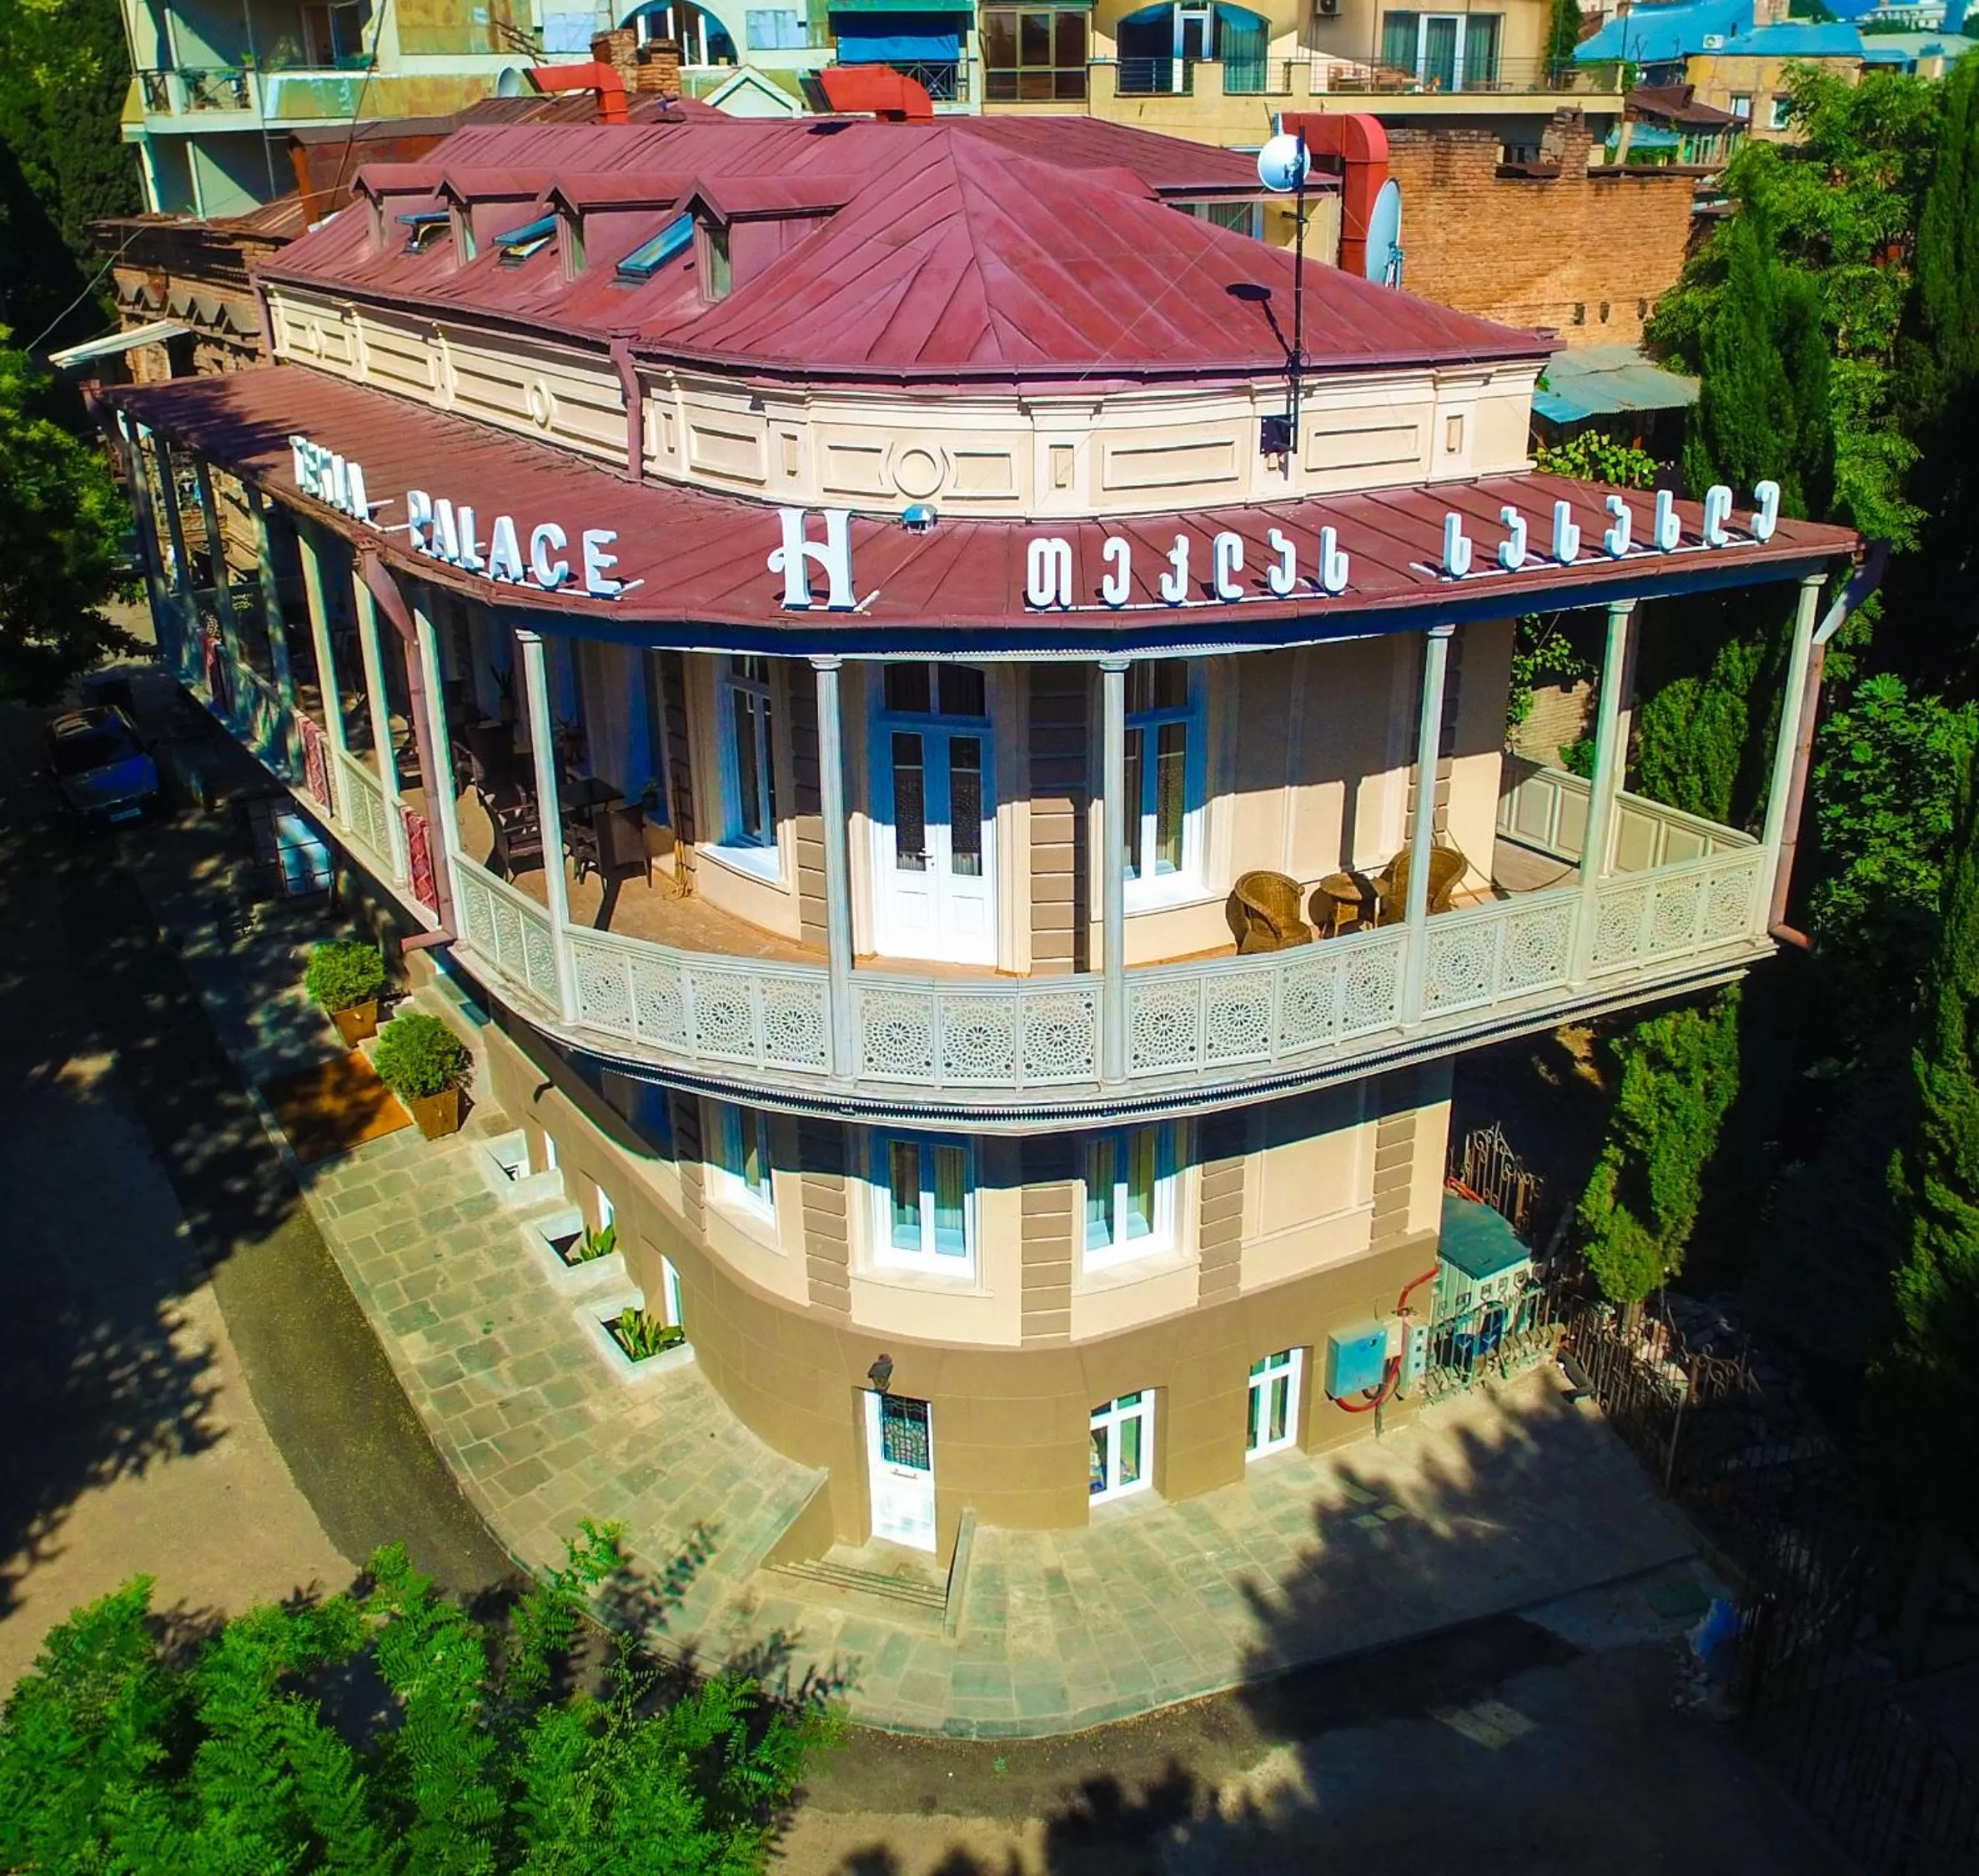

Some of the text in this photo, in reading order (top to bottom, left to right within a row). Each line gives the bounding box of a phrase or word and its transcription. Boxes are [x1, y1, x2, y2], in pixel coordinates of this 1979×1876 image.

[408, 489, 622, 594] PALACE
[1027, 480, 1780, 607] თეკლას სასახლე
